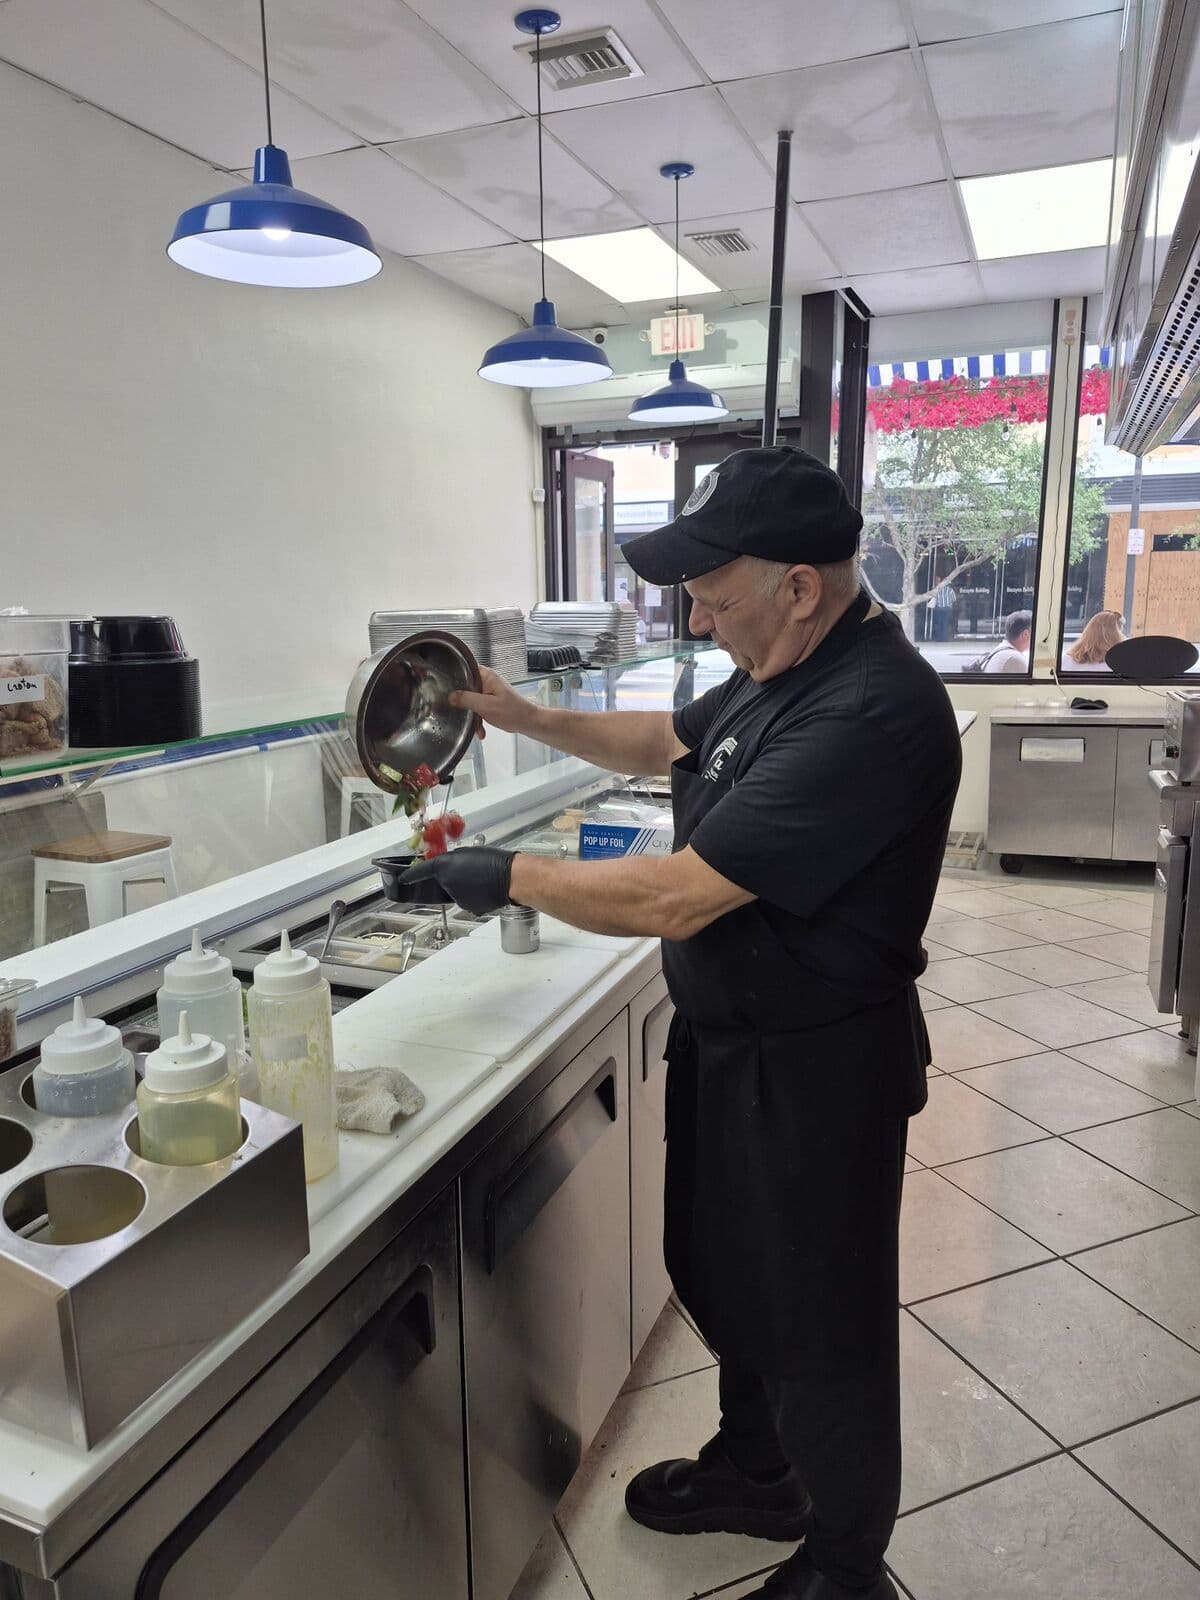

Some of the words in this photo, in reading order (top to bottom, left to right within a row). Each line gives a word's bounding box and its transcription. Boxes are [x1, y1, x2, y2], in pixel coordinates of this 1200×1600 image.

[660, 317, 696, 352] EXIT
[583, 835, 598, 846] POP
[598, 836, 609, 847] UP
[609, 837, 625, 848] FOIL
